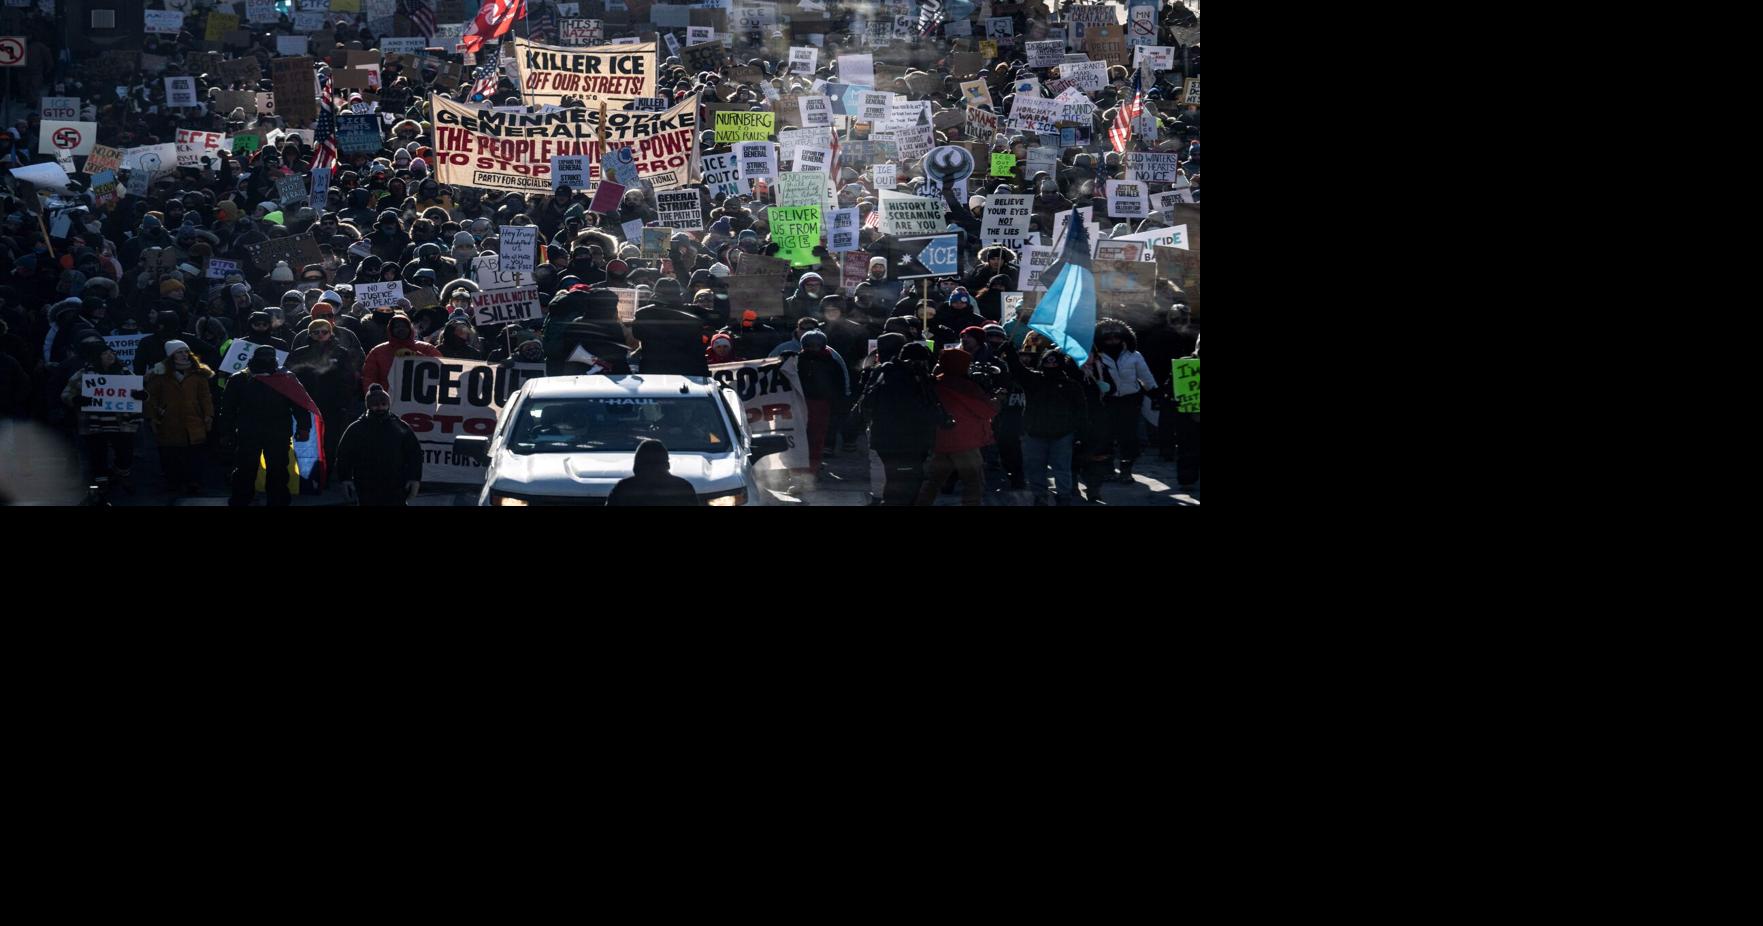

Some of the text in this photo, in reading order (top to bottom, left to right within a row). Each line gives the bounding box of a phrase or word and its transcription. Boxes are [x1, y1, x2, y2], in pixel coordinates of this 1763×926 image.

[526, 50, 645, 75] KILLER ICE
[526, 71, 645, 96] OFF OUR STREETS!
[639, 98, 665, 107] KILLER
[43, 107, 76, 118] GTFO
[477, 108, 662, 127] MINNESOTA
[968, 108, 997, 129] SHAME
[1019, 113, 1049, 123] WARM
[436, 110, 591, 139] GENERAL
[716, 130, 741, 142] NAZIS
[436, 126, 474, 153] THE
[477, 135, 552, 164] PEOPLE
[638, 127, 698, 162] POWE
[436, 152, 552, 178] TO STOP
[704, 156, 727, 171] ICE
[1148, 162, 1175, 172] HEARTS
[477, 174, 501, 185] PARTY
[501, 176, 516, 187] FOR
[706, 169, 740, 184] OUT O
[1136, 171, 1170, 181] NO ICE
[657, 192, 699, 203] GENERAL
[994, 198, 1025, 206] BELIEVE
[658, 201, 700, 212] STRIKE:
[889, 201, 940, 211] HISTORY IS
[1010, 208, 1029, 216] EYES
[660, 210, 701, 221] THE PATH TO
[772, 208, 819, 221] DELIVER
[888, 211, 942, 220] SCREAMING
[895, 220, 937, 230] ARE YOU
[998, 217, 1014, 226] NOT
[501, 228, 517, 241] Hey
[773, 222, 818, 235] US FROM
[987, 228, 1020, 236] THE LIES
[777, 234, 811, 249] ICE
[929, 246, 958, 265] ICE
[367, 285, 378, 293] NO
[359, 291, 393, 301] JUSTICE
[474, 289, 539, 307] WE WILL NOT BE
[373, 298, 398, 307] PEACE
[478, 301, 533, 324] SILENT
[86, 377, 107, 389] NO
[400, 359, 464, 406] ICE
[105, 401, 135, 411] ICE
[400, 413, 497, 436] STO
